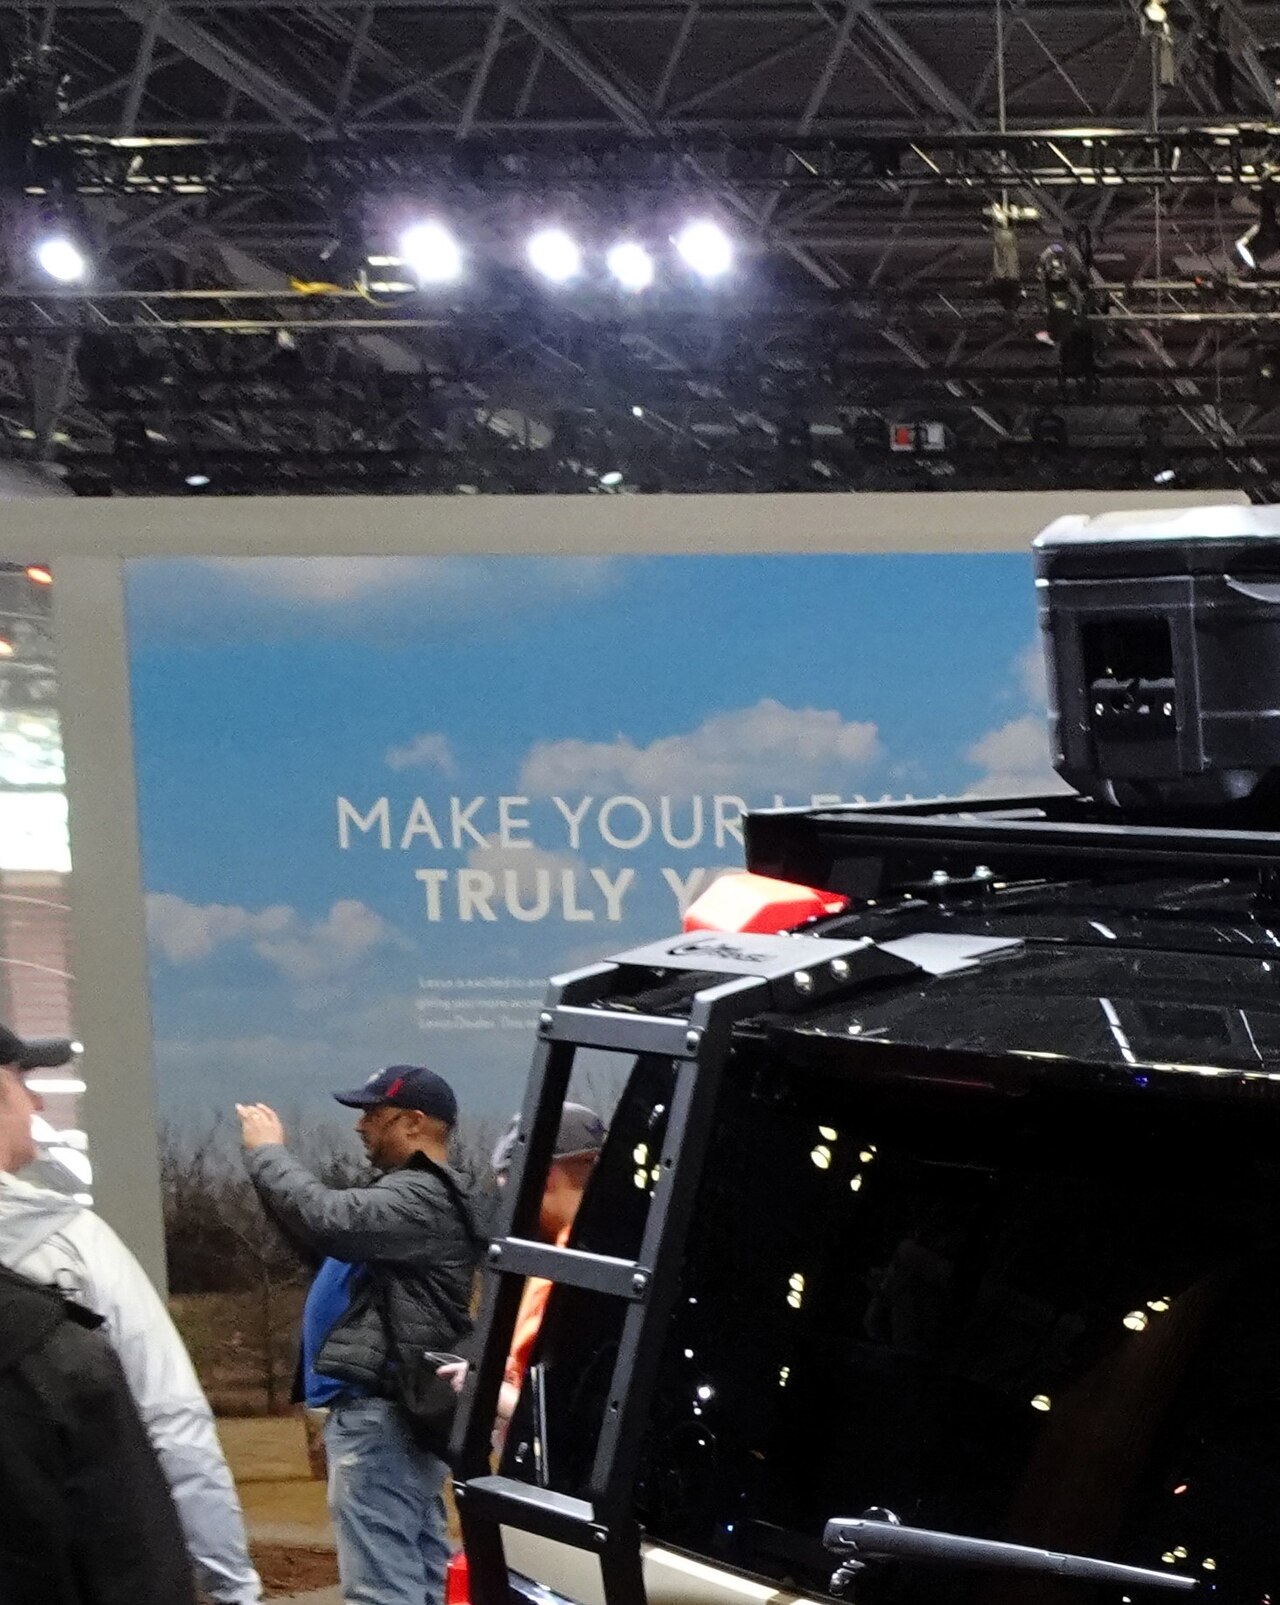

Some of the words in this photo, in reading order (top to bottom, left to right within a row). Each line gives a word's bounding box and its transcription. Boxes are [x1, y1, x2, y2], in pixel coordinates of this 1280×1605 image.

[337, 796, 533, 850] MAKE
[553, 795, 744, 850] YOUR
[415, 868, 635, 922] TRULY
